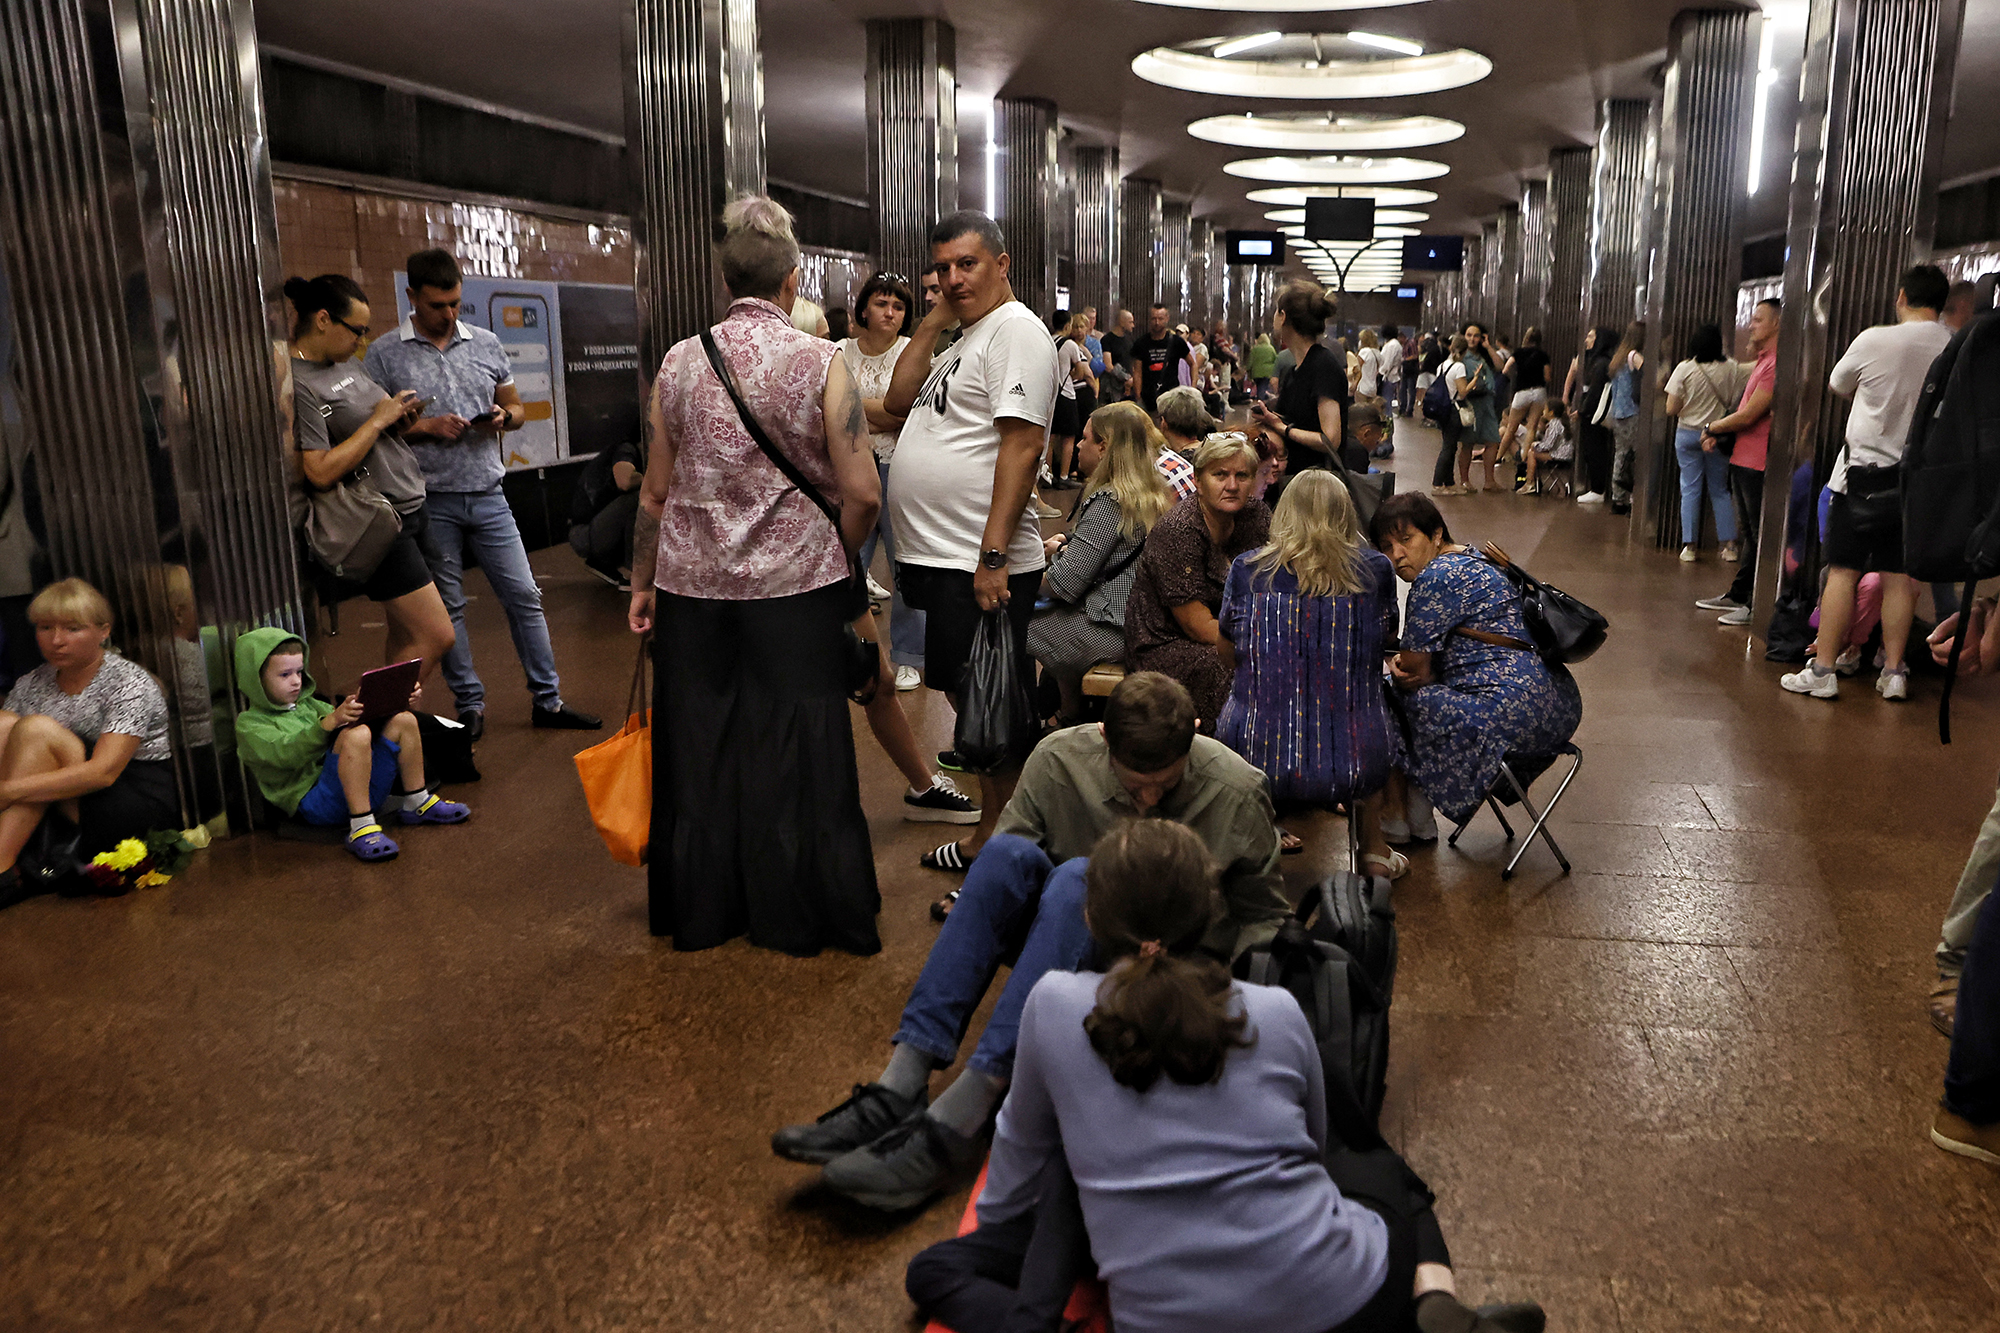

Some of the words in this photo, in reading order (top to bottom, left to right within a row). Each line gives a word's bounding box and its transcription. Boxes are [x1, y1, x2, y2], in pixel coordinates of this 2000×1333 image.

[589, 345, 605, 355] 2022
[574, 361, 590, 371] 2024
[1008, 389, 1026, 398] adidas
